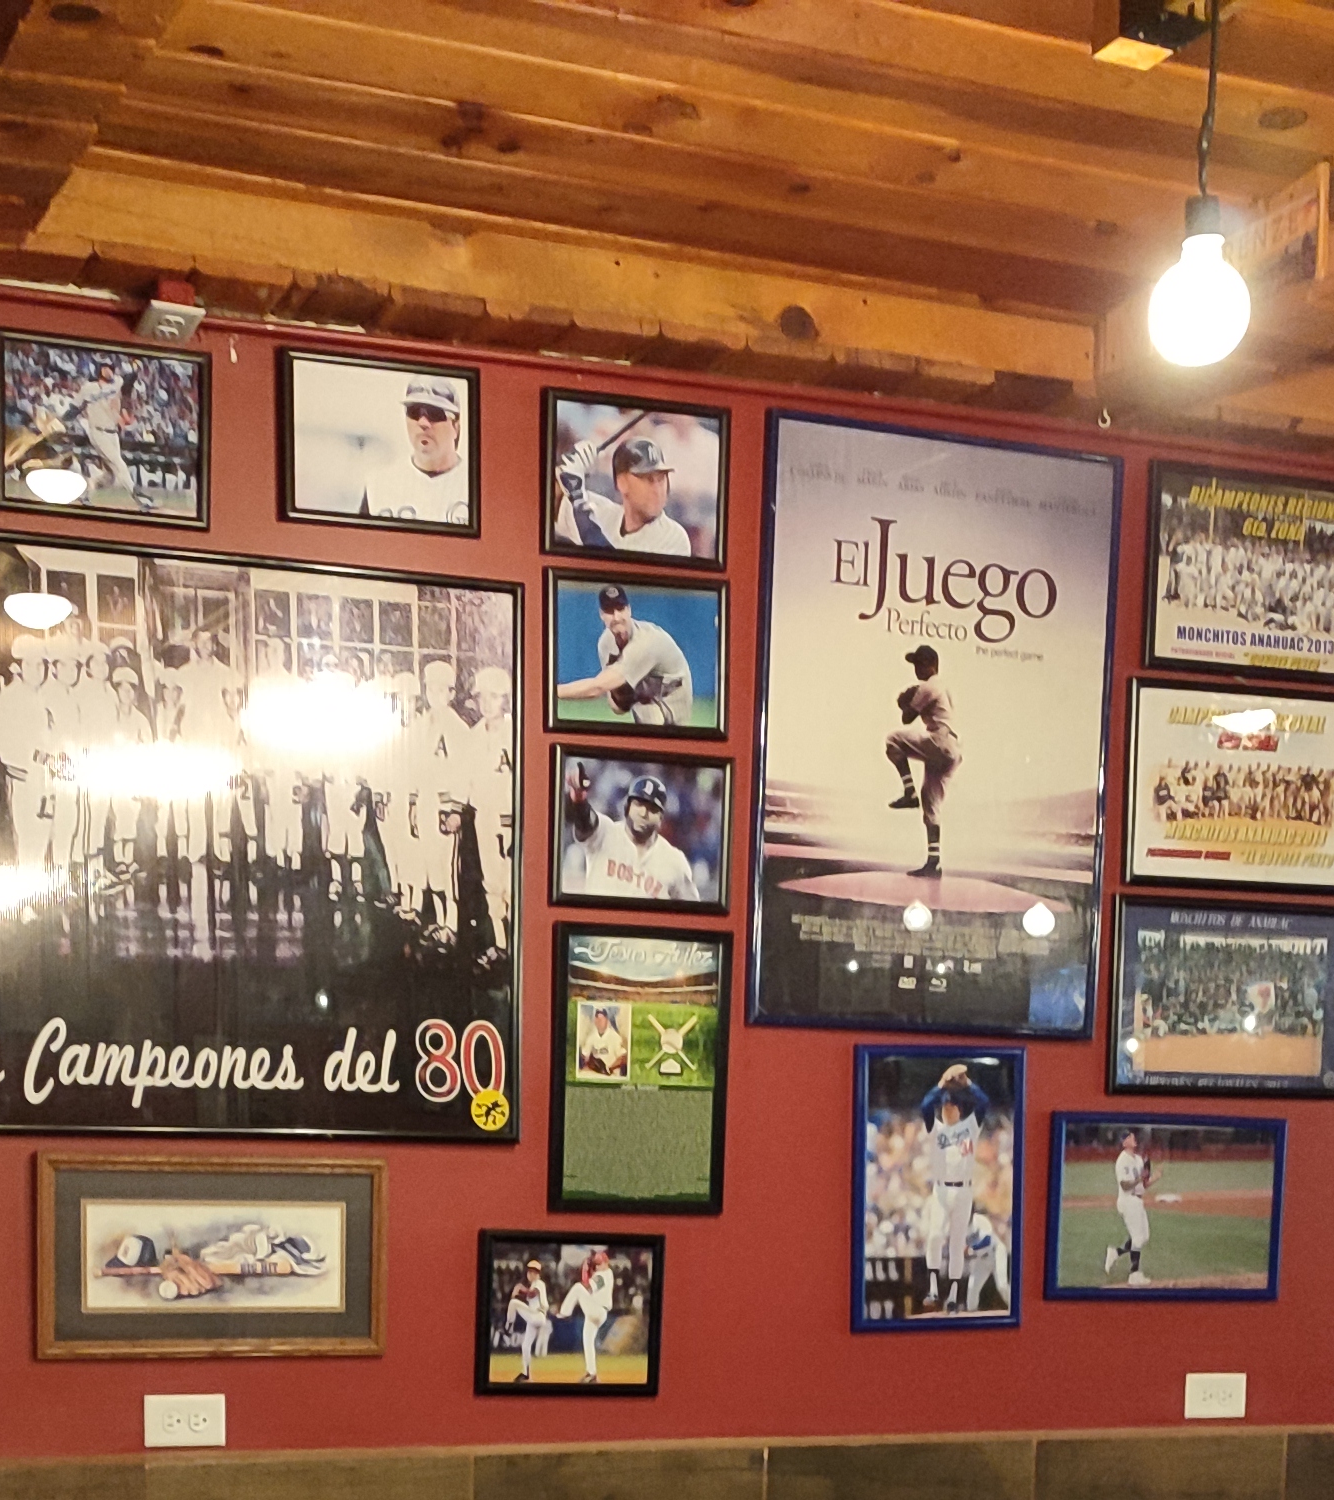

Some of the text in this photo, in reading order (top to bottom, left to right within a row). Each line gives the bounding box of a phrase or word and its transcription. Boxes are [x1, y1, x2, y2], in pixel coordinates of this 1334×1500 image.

[830, 516, 1057, 644] El Juego
[886, 607, 968, 643] Perfecto
[1176, 625, 1334, 655] MONCHITOS ANAHUAC 2013
[989, 647, 1018, 662] perfect
[434, 734, 448, 758] A
[607, 859, 663, 898] BOSTON
[23, 1017, 304, 1108] Campeones
[323, 1026, 400, 1093] del
[415, 1018, 506, 1103] 80
